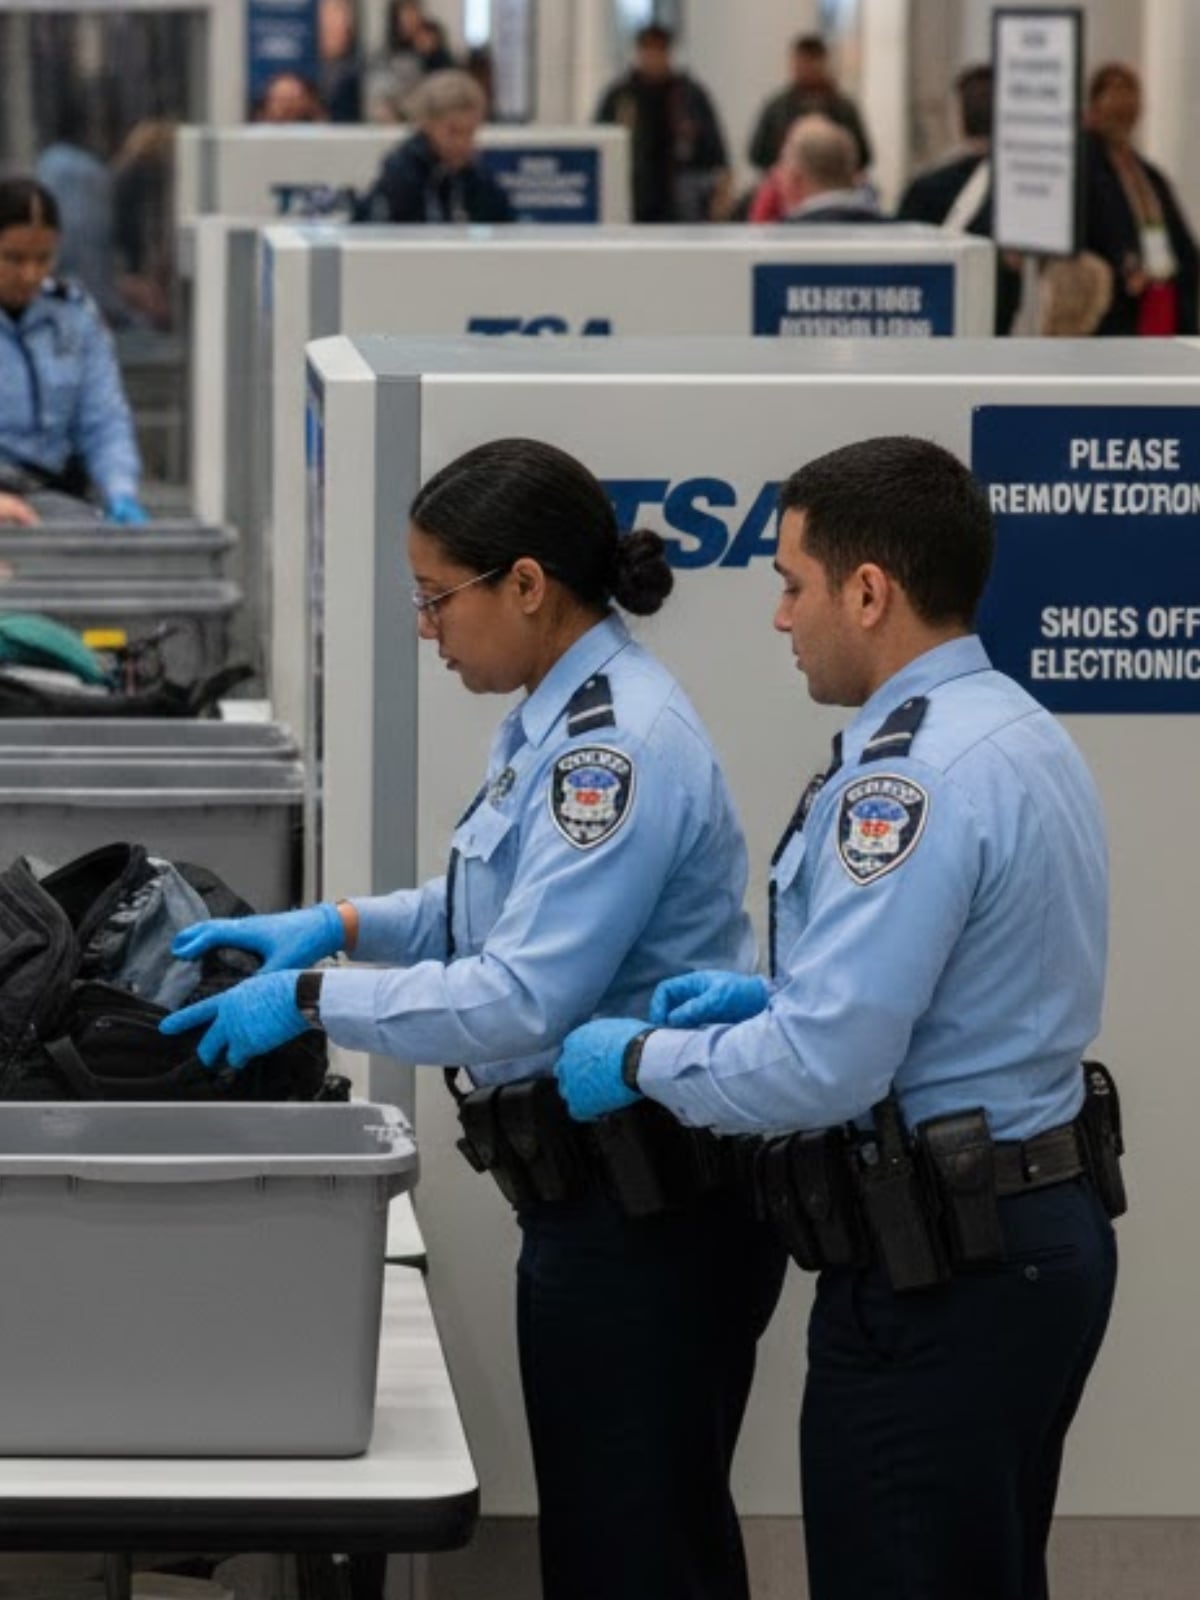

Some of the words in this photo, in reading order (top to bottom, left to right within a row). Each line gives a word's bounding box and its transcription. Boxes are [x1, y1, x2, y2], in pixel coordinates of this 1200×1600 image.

[1070, 438, 1180, 471] PLEASE
[1040, 606, 1139, 638] SHOES
[1147, 606, 1200, 638] OFF
[1031, 648, 1200, 680] ELECTRONIC
